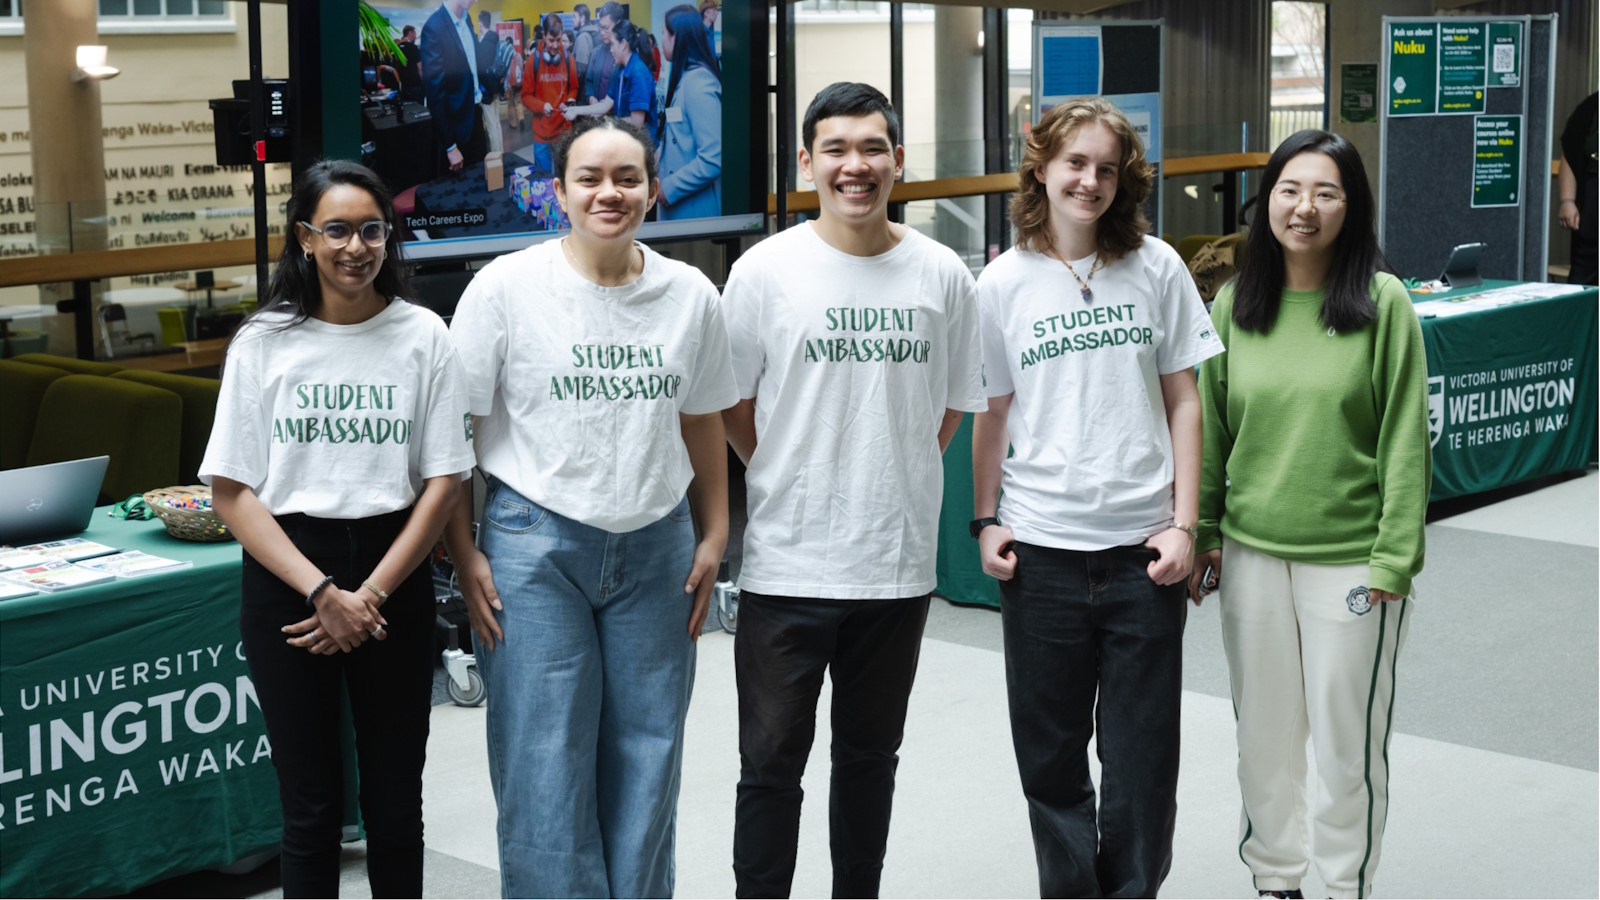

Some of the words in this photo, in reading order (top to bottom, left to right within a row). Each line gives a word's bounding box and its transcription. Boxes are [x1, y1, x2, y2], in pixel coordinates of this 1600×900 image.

[1393, 28, 1405, 36] Ask
[1415, 28, 1433, 36] about
[1394, 40, 1425, 54] Nuku
[1496, 121, 1509, 129] your
[140, 164, 174, 179] MAURI
[167, 187, 188, 202] KIA
[190, 184, 234, 201] ORANA
[142, 209, 196, 224] Welcome
[406, 217, 427, 227] Tech
[429, 214, 462, 226] Careers
[463, 212, 484, 224] Expo
[825, 307, 917, 332] STUDENT
[1033, 304, 1136, 338] STUDENT
[572, 343, 665, 370] STUDENT
[804, 338, 931, 364] AMBASSADOR
[1020, 326, 1153, 370] AMBASSADOR
[1450, 370, 1497, 389] VICTORIA
[1500, 360, 1559, 382] UNIVERSITY
[1560, 358, 1574, 372] OF
[296, 383, 397, 411] STUDENT
[1449, 377, 1575, 425] WELLINGTON
[1449, 432, 1463, 450] TE
[1468, 420, 1530, 447] HERENGA
[20, 644, 223, 710] UNIVERSITY
[158, 734, 272, 786] WAKA
